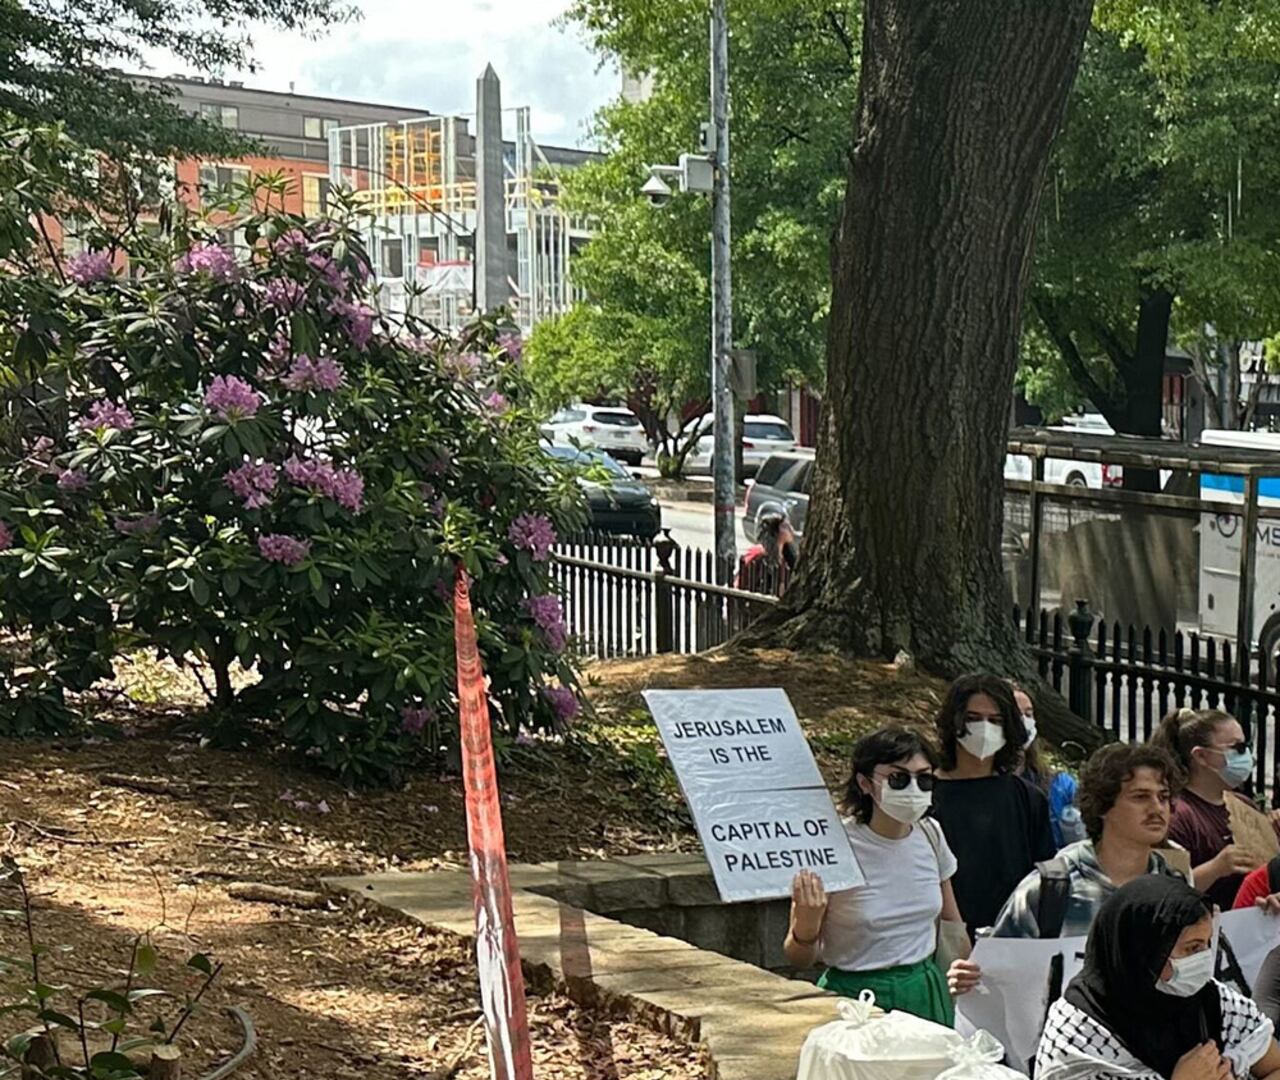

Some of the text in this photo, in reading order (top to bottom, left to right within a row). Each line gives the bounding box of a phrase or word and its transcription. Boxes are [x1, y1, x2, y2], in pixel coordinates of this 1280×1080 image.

[673, 718, 787, 739] JERUSALEM
[710, 745, 772, 764] IS THE
[711, 819, 830, 843] CAPITAL OF
[724, 848, 838, 872] PALESTINE
